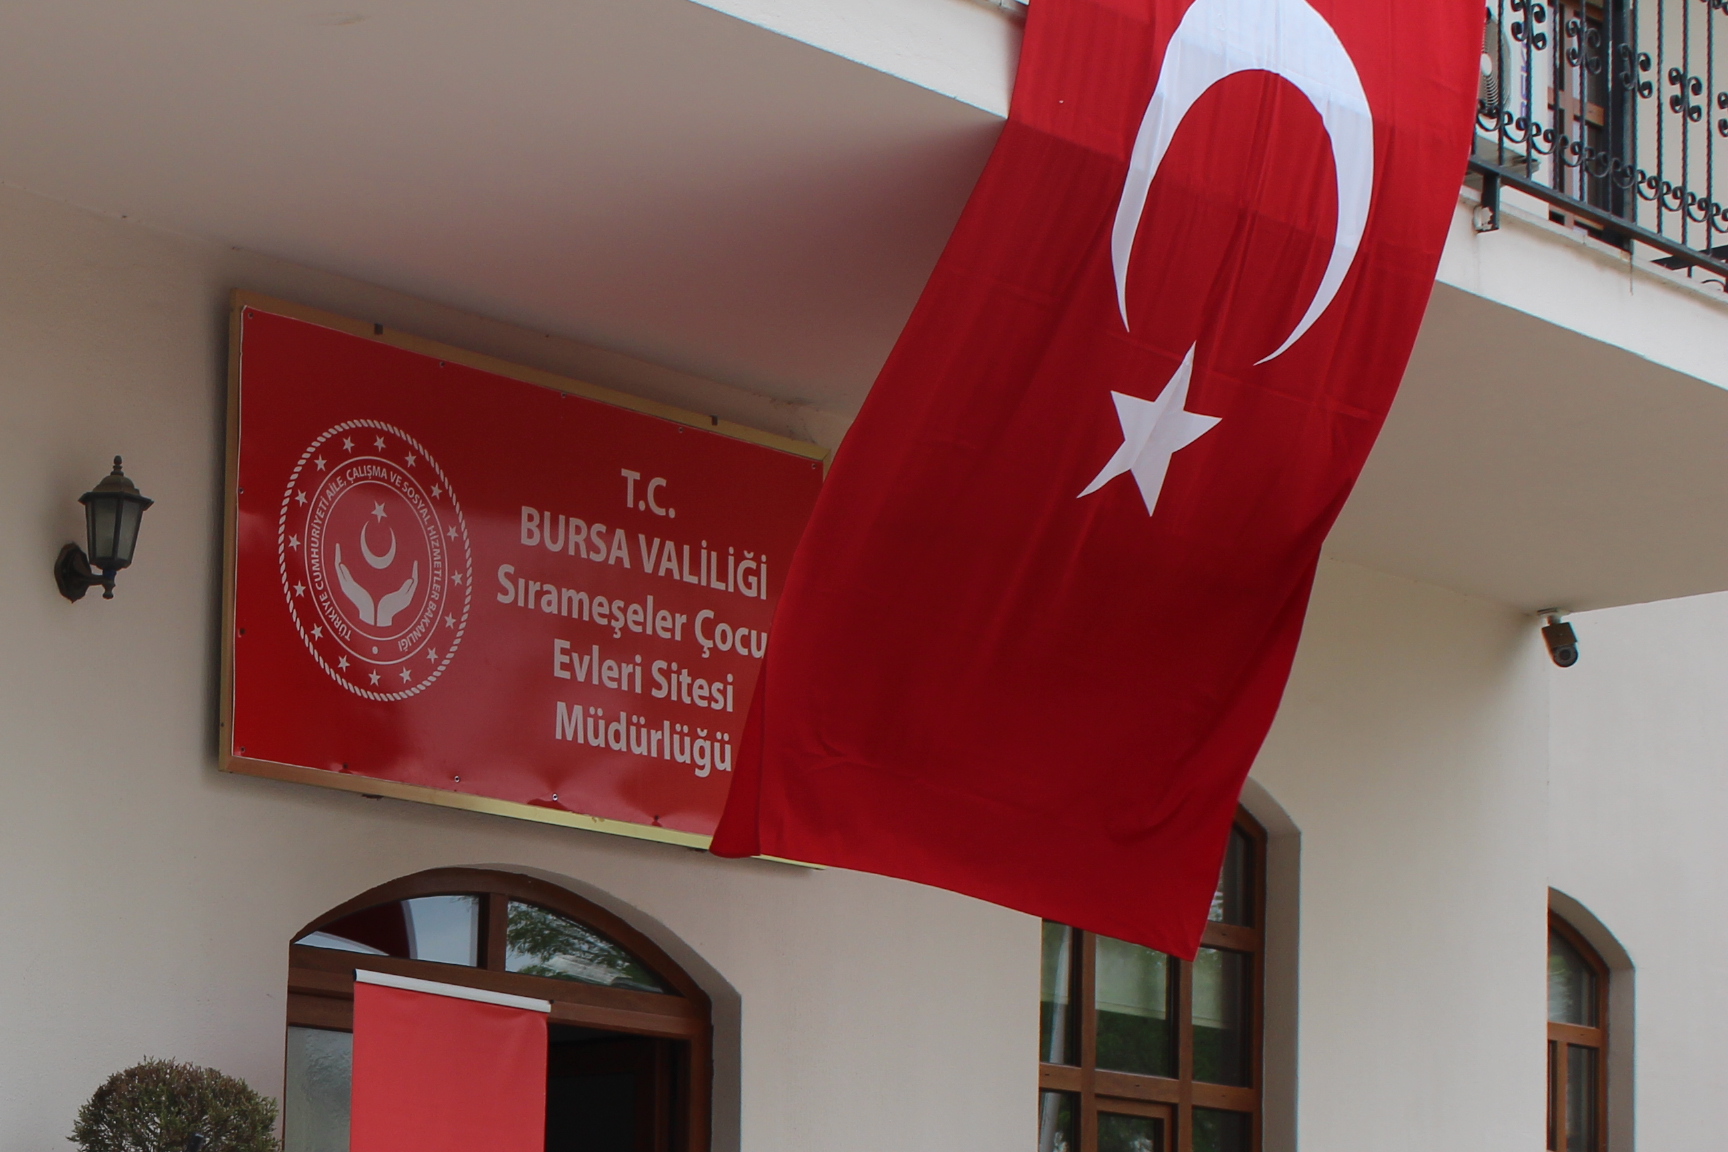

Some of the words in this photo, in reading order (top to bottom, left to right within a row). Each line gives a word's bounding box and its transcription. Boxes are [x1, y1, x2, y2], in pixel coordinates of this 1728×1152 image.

[326, 476, 347, 499] AİLE,
[346, 465, 387, 480] ÇALIŞMA
[390, 470, 403, 487] VE
[621, 468, 676, 519] T.C.
[401, 481, 430, 526] SOSYAL
[310, 495, 329, 591] CUMHURİYETİ
[428, 525, 442, 604] HİZMETLER
[521, 505, 631, 569] BURSA
[638, 532, 767, 600] VALİLİĞİ
[320, 592, 352, 642] TÜRKİYE
[398, 602, 437, 653] BAKANLIĞI
[497, 564, 687, 641] Sırameşeler
[554, 638, 642, 694] Evleri
[651, 659, 734, 712] Sitesi
[555, 700, 732, 778] Müdürlüğü
